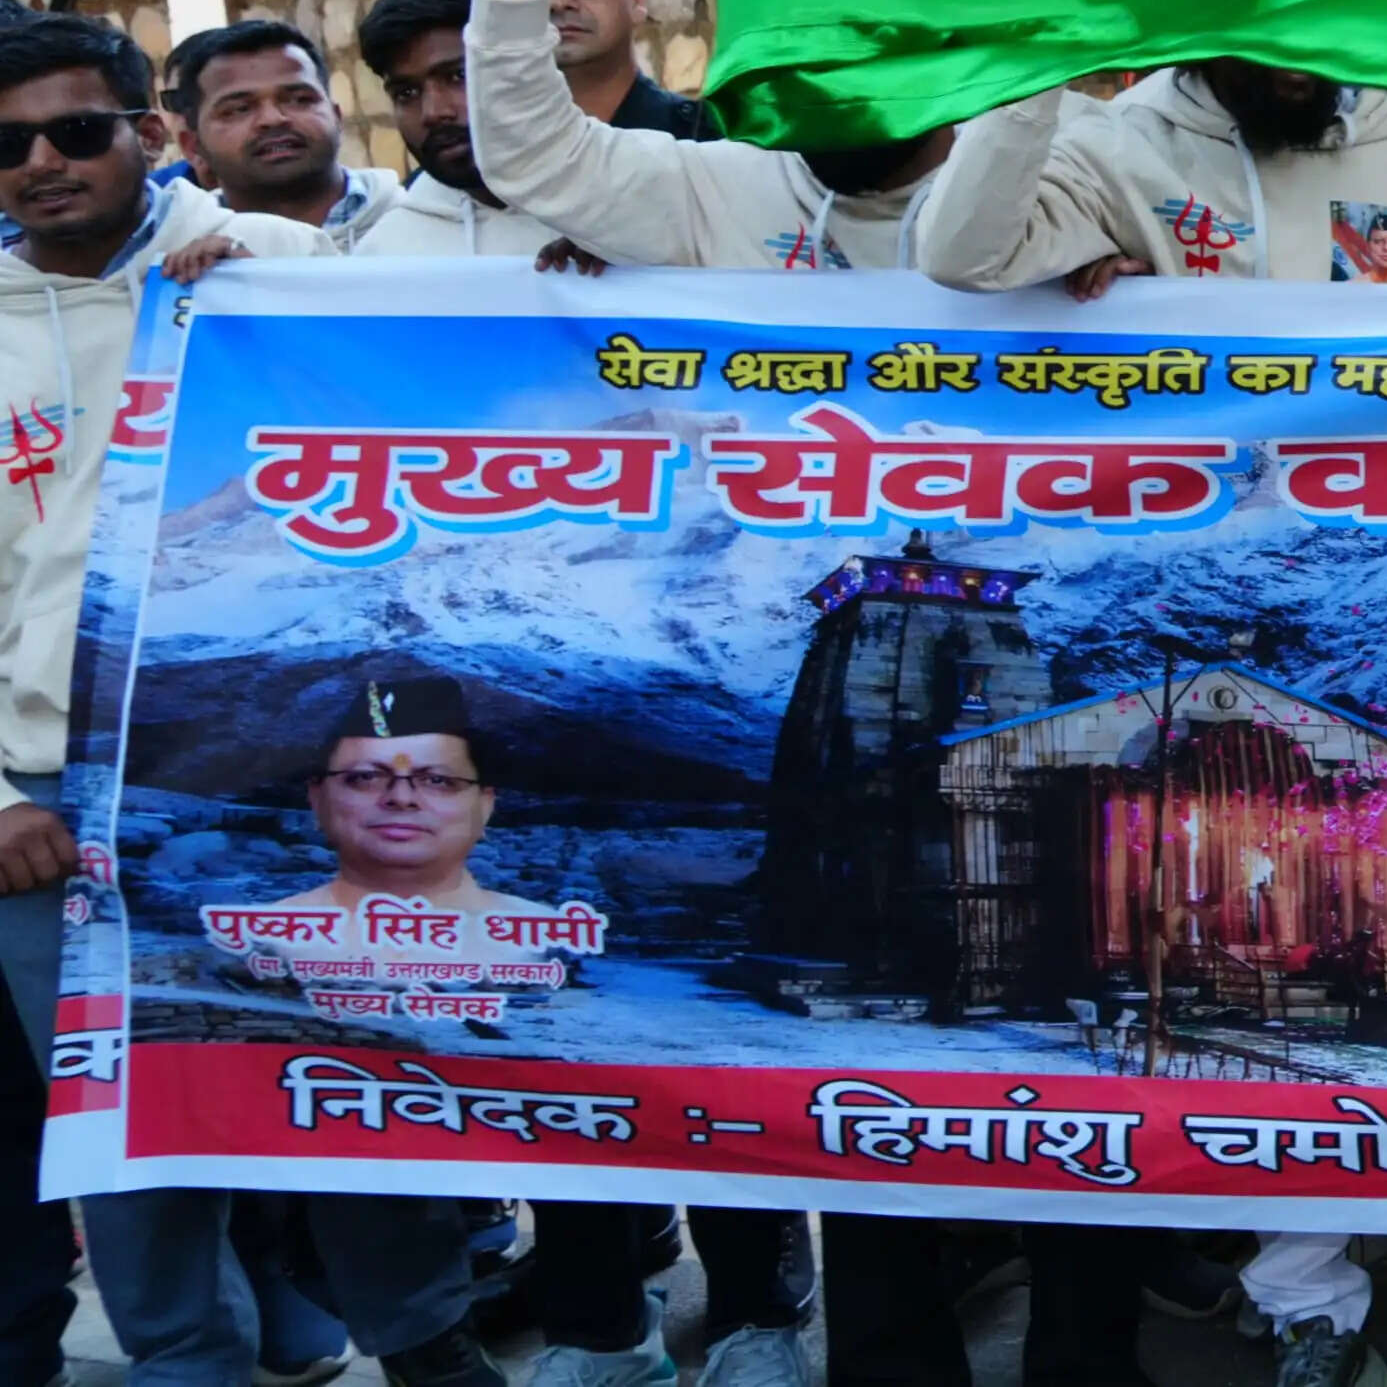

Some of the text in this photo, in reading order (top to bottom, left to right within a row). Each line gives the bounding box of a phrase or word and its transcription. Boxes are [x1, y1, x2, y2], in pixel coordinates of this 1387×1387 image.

[599, 335, 704, 390] सेवा
[725, 350, 847, 392] श्रद्धा
[870, 342, 977, 393] और
[1000, 347, 1208, 409] संस्कृति
[1229, 355, 1314, 394] का
[250, 428, 674, 552] मुख्य
[704, 407, 1229, 522] सेवक
[205, 898, 604, 950] पुष्कर सिंह धामी
[309, 985, 502, 1020] मुख्य सेवक
[489, 959, 565, 988] सरकार)
[282, 1055, 636, 1143] निवेदक
[807, 1078, 1141, 1185] हिमांशु
